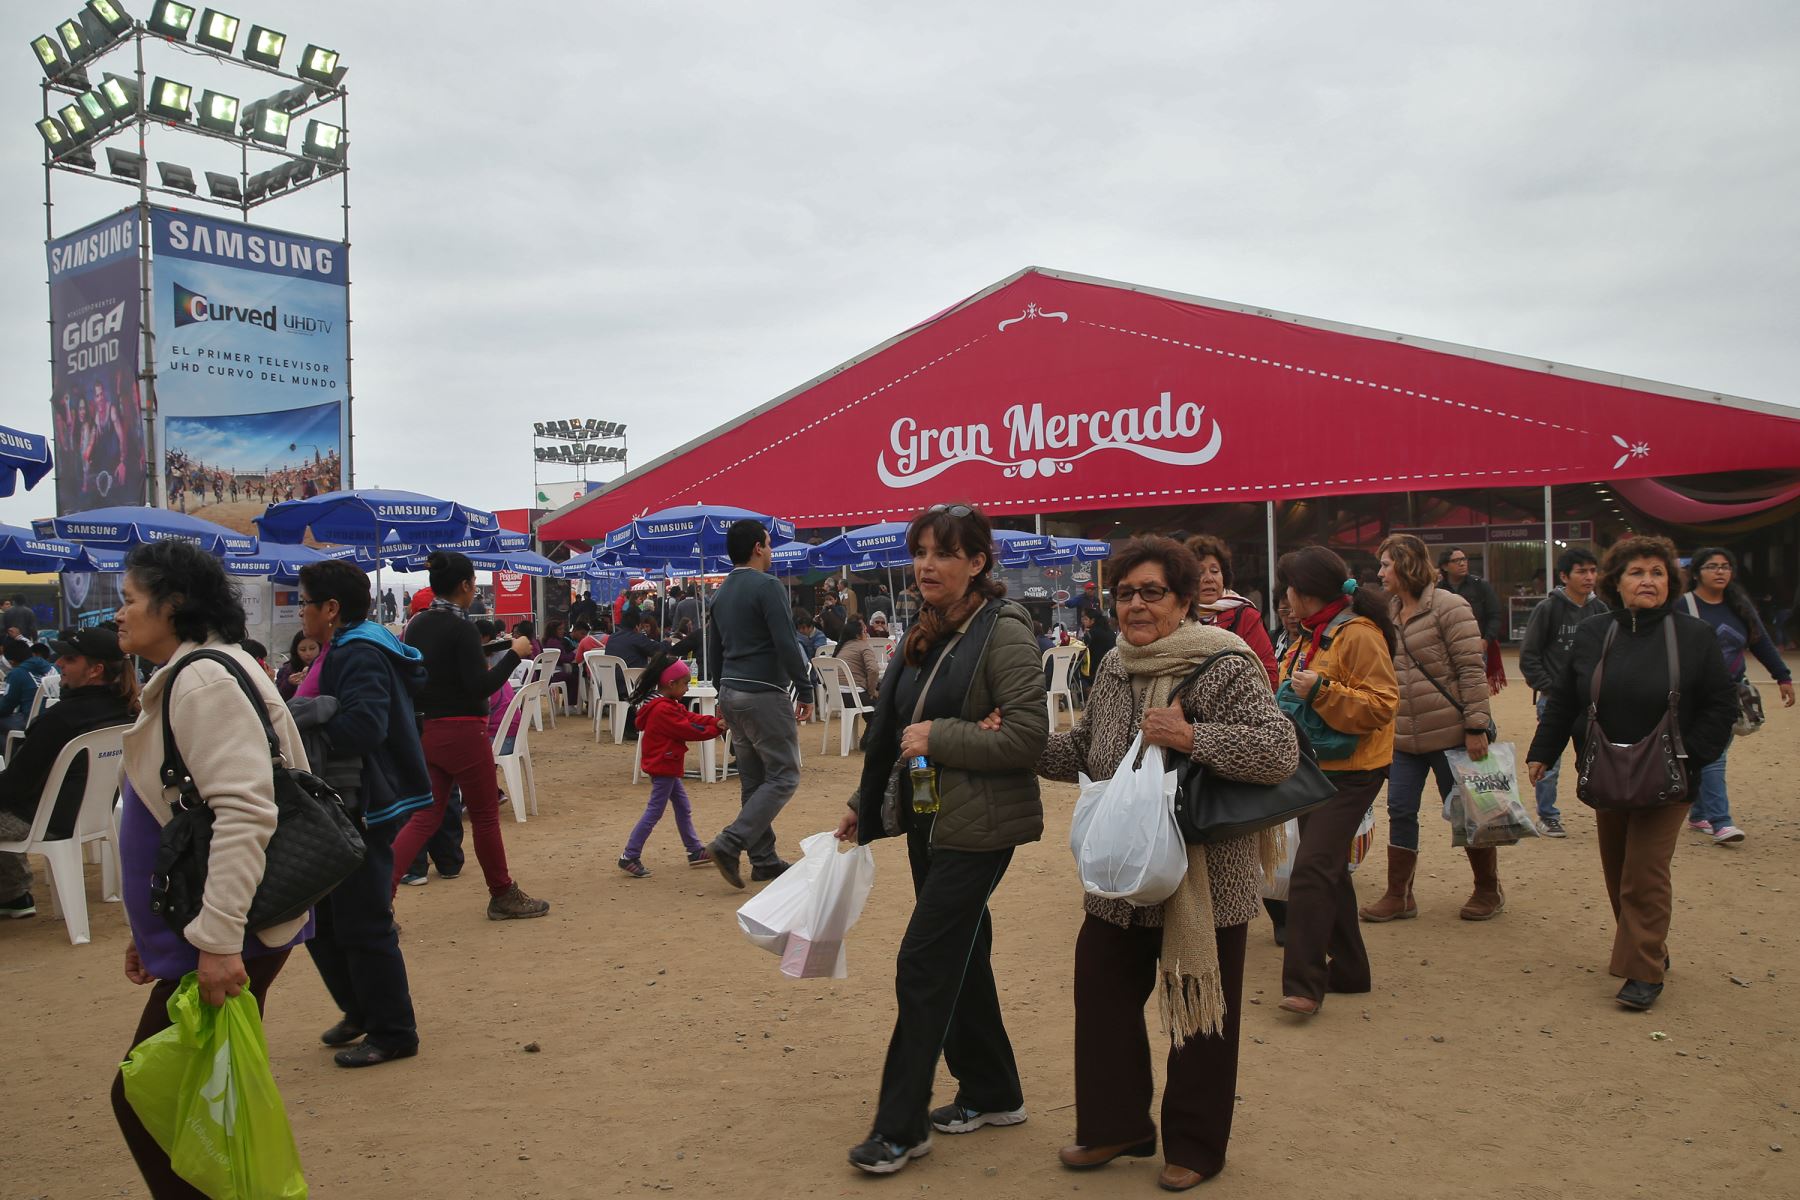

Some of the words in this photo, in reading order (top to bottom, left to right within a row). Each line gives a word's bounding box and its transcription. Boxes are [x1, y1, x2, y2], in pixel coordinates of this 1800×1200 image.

[52, 220, 132, 275] SAMSUNG
[168, 220, 333, 275] SAMSUNG
[190, 296, 277, 332] Curved
[62, 300, 126, 351] GIGA
[67, 338, 119, 375] SOUND
[172, 346, 190, 355] EL
[198, 348, 251, 363] PRIMER
[258, 356, 329, 372] TELEVISOR
[170, 361, 200, 373] UHD
[208, 365, 254, 379] CURVO
[261, 371, 285, 383] DEL
[292, 376, 337, 388] MUNDO
[890, 417, 994, 474] Gran
[1003, 391, 1205, 459] Mercado
[378, 505, 438, 516] SAMSUNG
[67, 524, 118, 535] SAMSUNG
[648, 522, 694, 533] SAMSUNG
[26, 541, 71, 553] SAMSUNG
[501, 538, 525, 546] SAMSUNG
[856, 535, 897, 547] SAMSUNG
[1013, 539, 1042, 547] SAMSUNG
[230, 562, 270, 570] SAMSUNG
[514, 563, 543, 573] SAMSUNG
